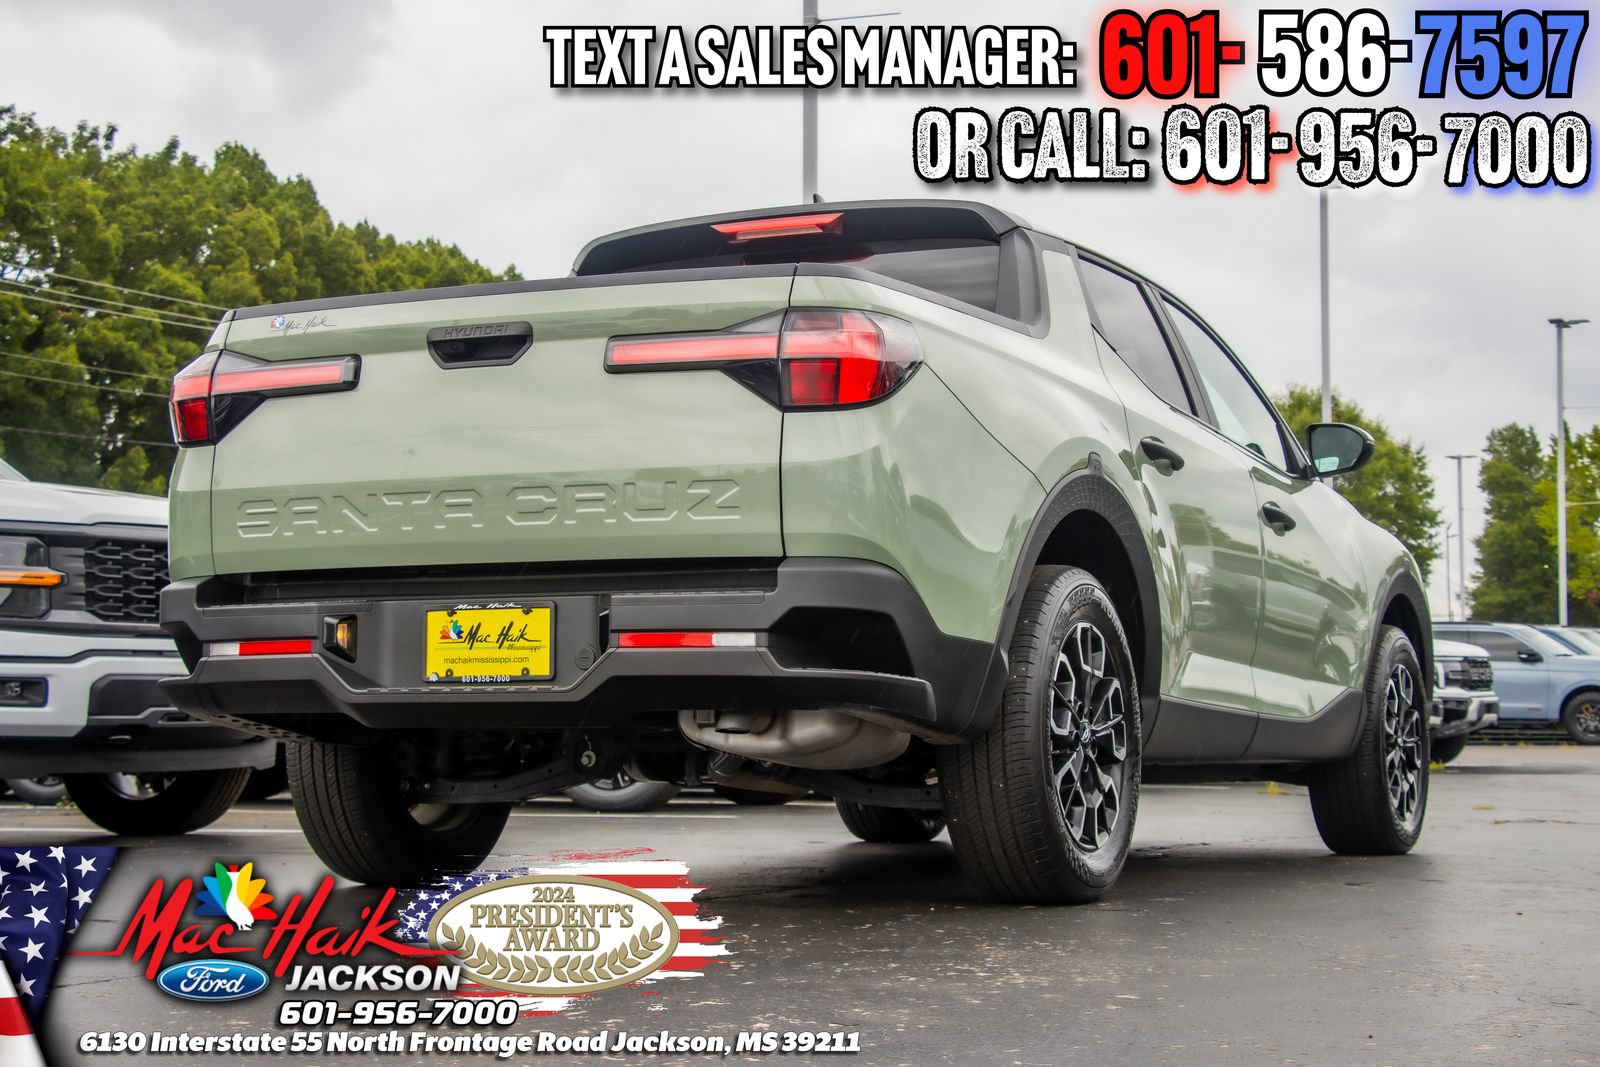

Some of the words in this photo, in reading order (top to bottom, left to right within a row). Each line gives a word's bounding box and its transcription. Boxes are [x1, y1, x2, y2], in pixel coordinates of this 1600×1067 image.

[444, 323, 511, 337] HYUNDAI
[237, 488, 484, 538] SANTA
[506, 478, 741, 525] CRUZ
[454, 622, 490, 650] Mac
[496, 621, 541, 649] Haik
[443, 655, 529, 665] machaikmississippi.com
[461, 675, 510, 683] 601-956-7000
